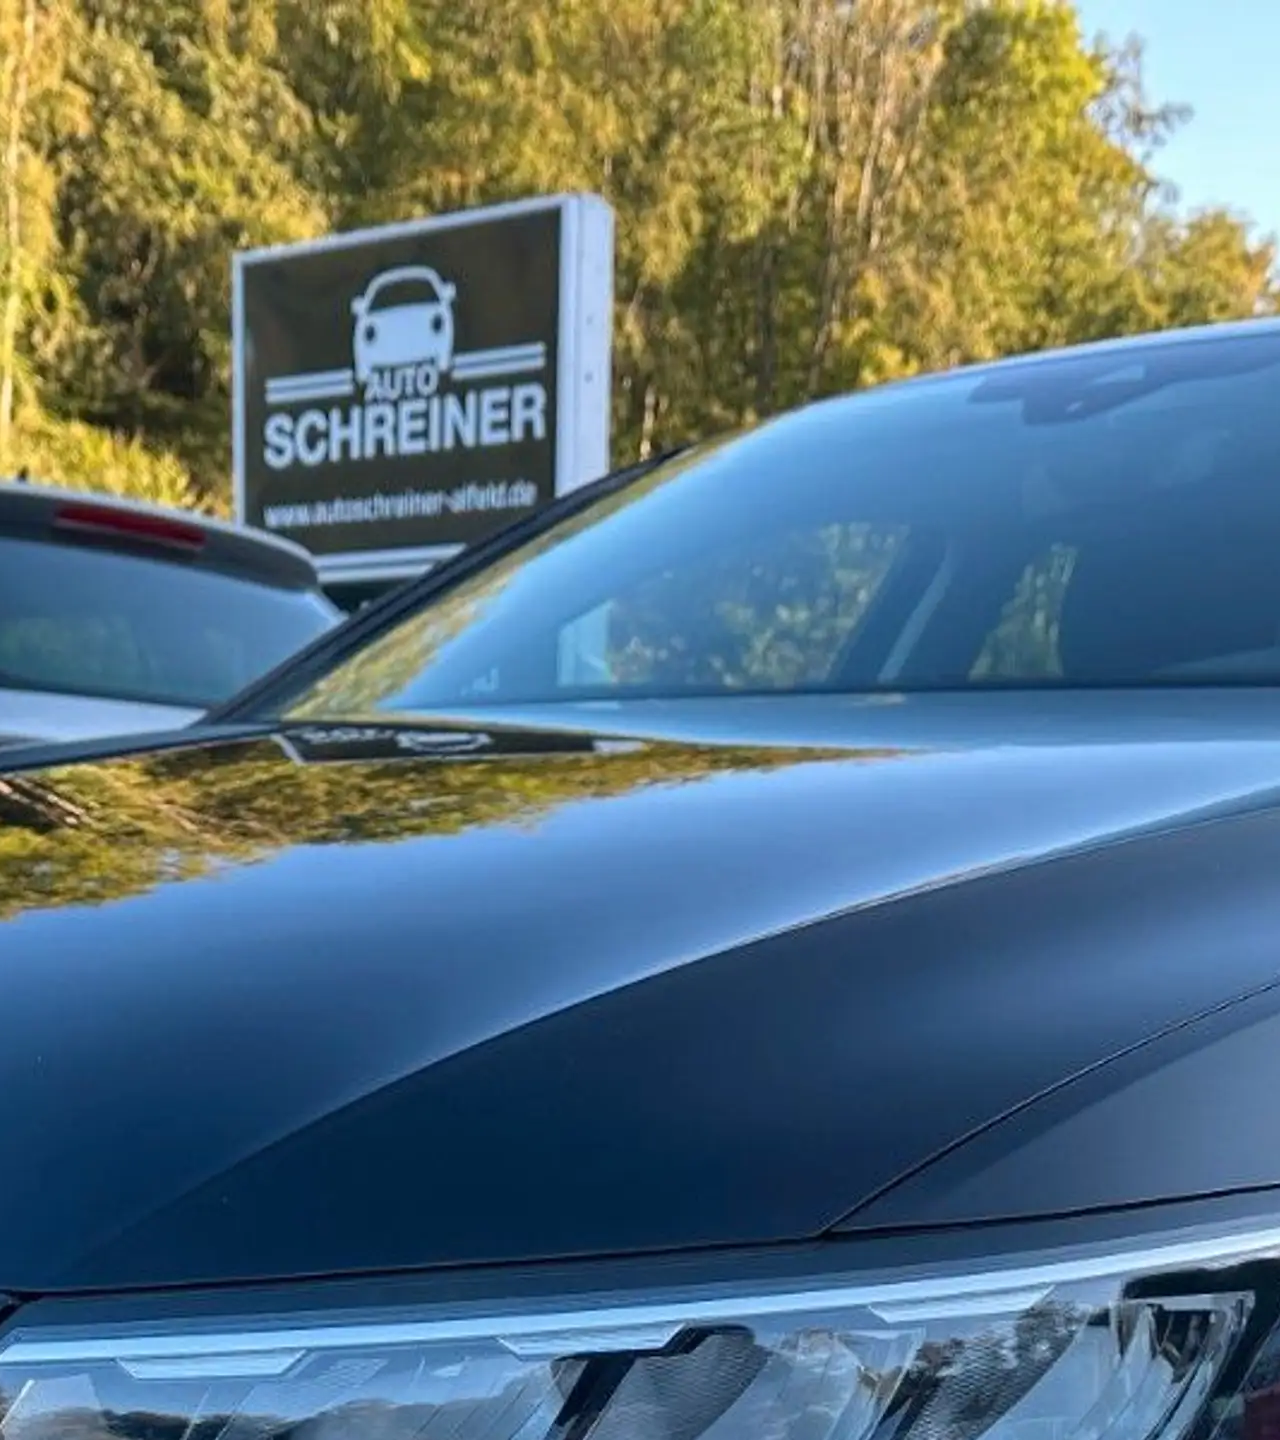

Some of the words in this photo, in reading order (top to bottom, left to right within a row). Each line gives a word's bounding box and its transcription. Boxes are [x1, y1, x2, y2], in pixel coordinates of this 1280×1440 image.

[364, 363, 440, 401] AUTO
[263, 382, 547, 470] SCHREINER
[264, 479, 538, 528] www.autoschreiner-alfeld.de
